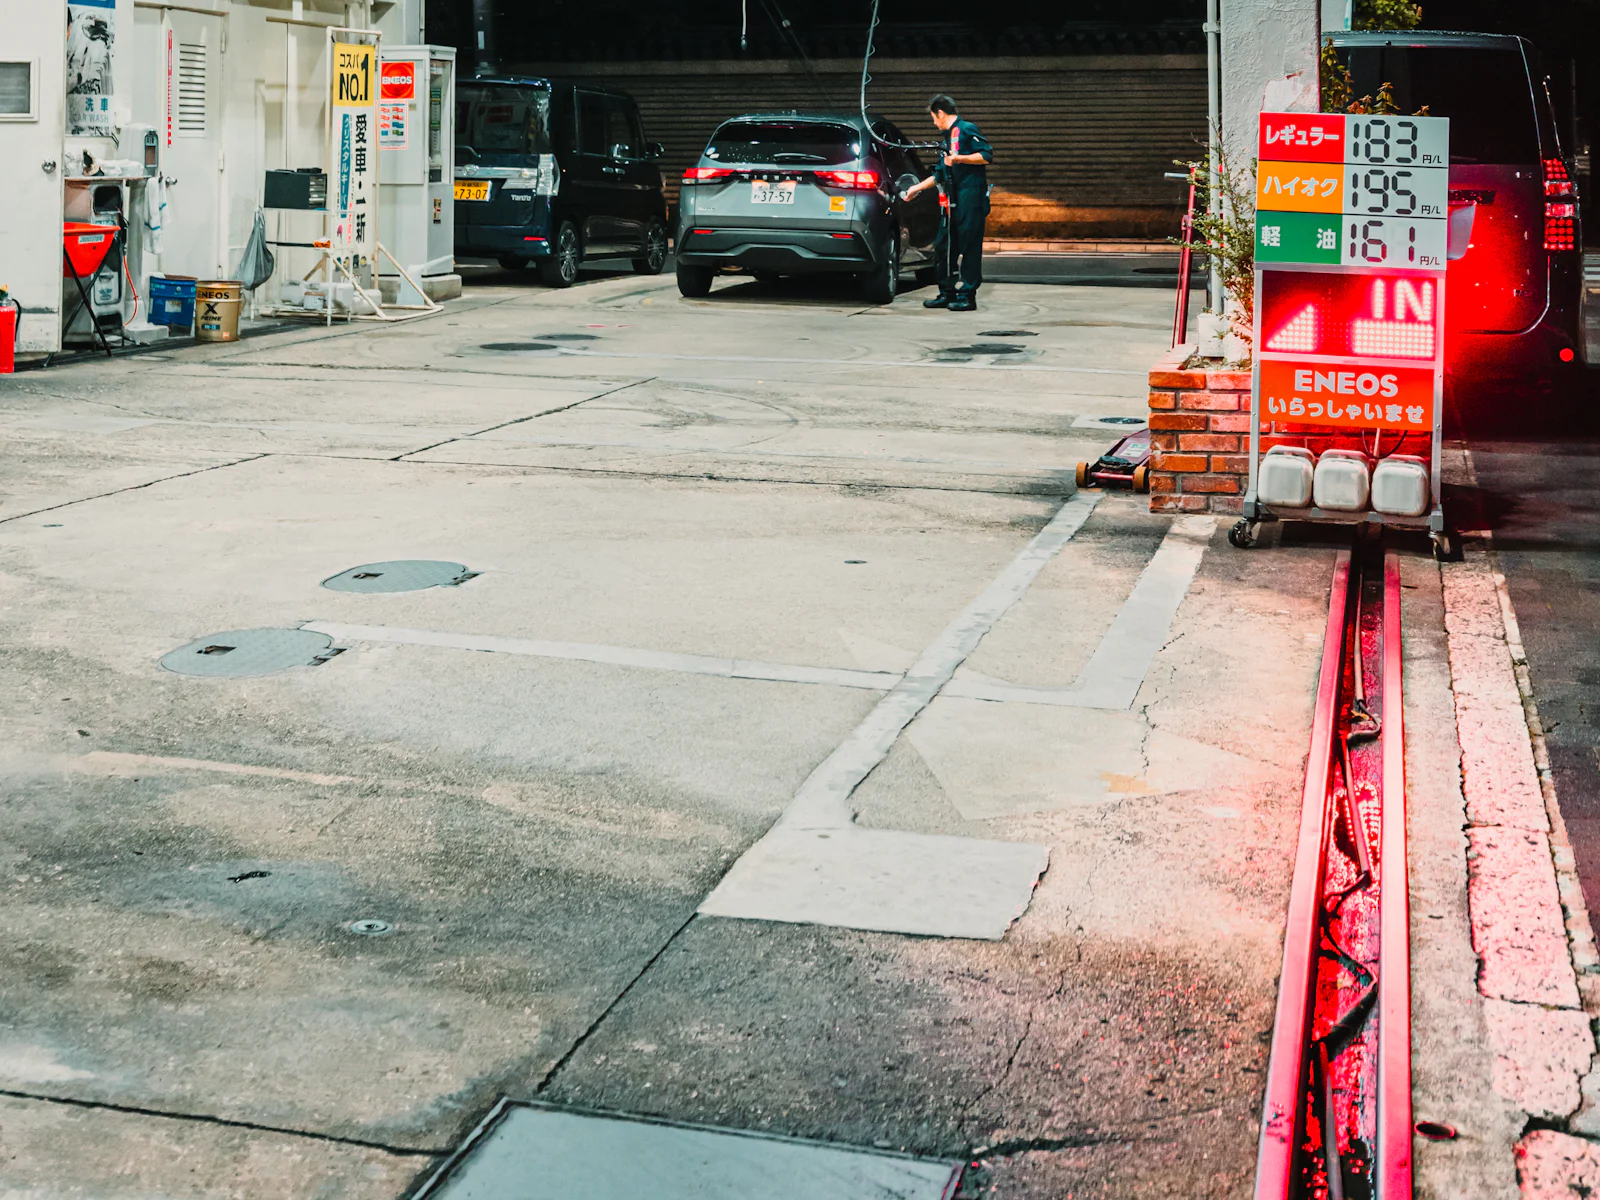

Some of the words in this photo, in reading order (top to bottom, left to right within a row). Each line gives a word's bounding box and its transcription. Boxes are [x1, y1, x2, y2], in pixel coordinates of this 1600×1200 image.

[339, 53, 369, 101] NO.1
[381, 75, 413, 85] ENEOS
[89, 113, 108, 123] WASH
[1265, 124, 1340, 146] レギュラー
[1353, 119, 1418, 164] 183
[1422, 154, 1443, 164] 円/L
[459, 188, 488, 200] 73-07
[760, 191, 792, 203] 37-57
[1263, 176, 1338, 197] ハイオク
[1351, 169, 1417, 215] 195
[1421, 205, 1441, 215] 円/L
[1260, 225, 1336, 250] 軽油
[1349, 220, 1416, 263] 161
[1419, 256, 1440, 266] 円/L
[197, 291, 230, 299] ENEOS
[1373, 277, 1432, 321] IN
[1294, 369, 1399, 397] ENEOS
[1268, 396, 1424, 424] いらっしゃいませ
